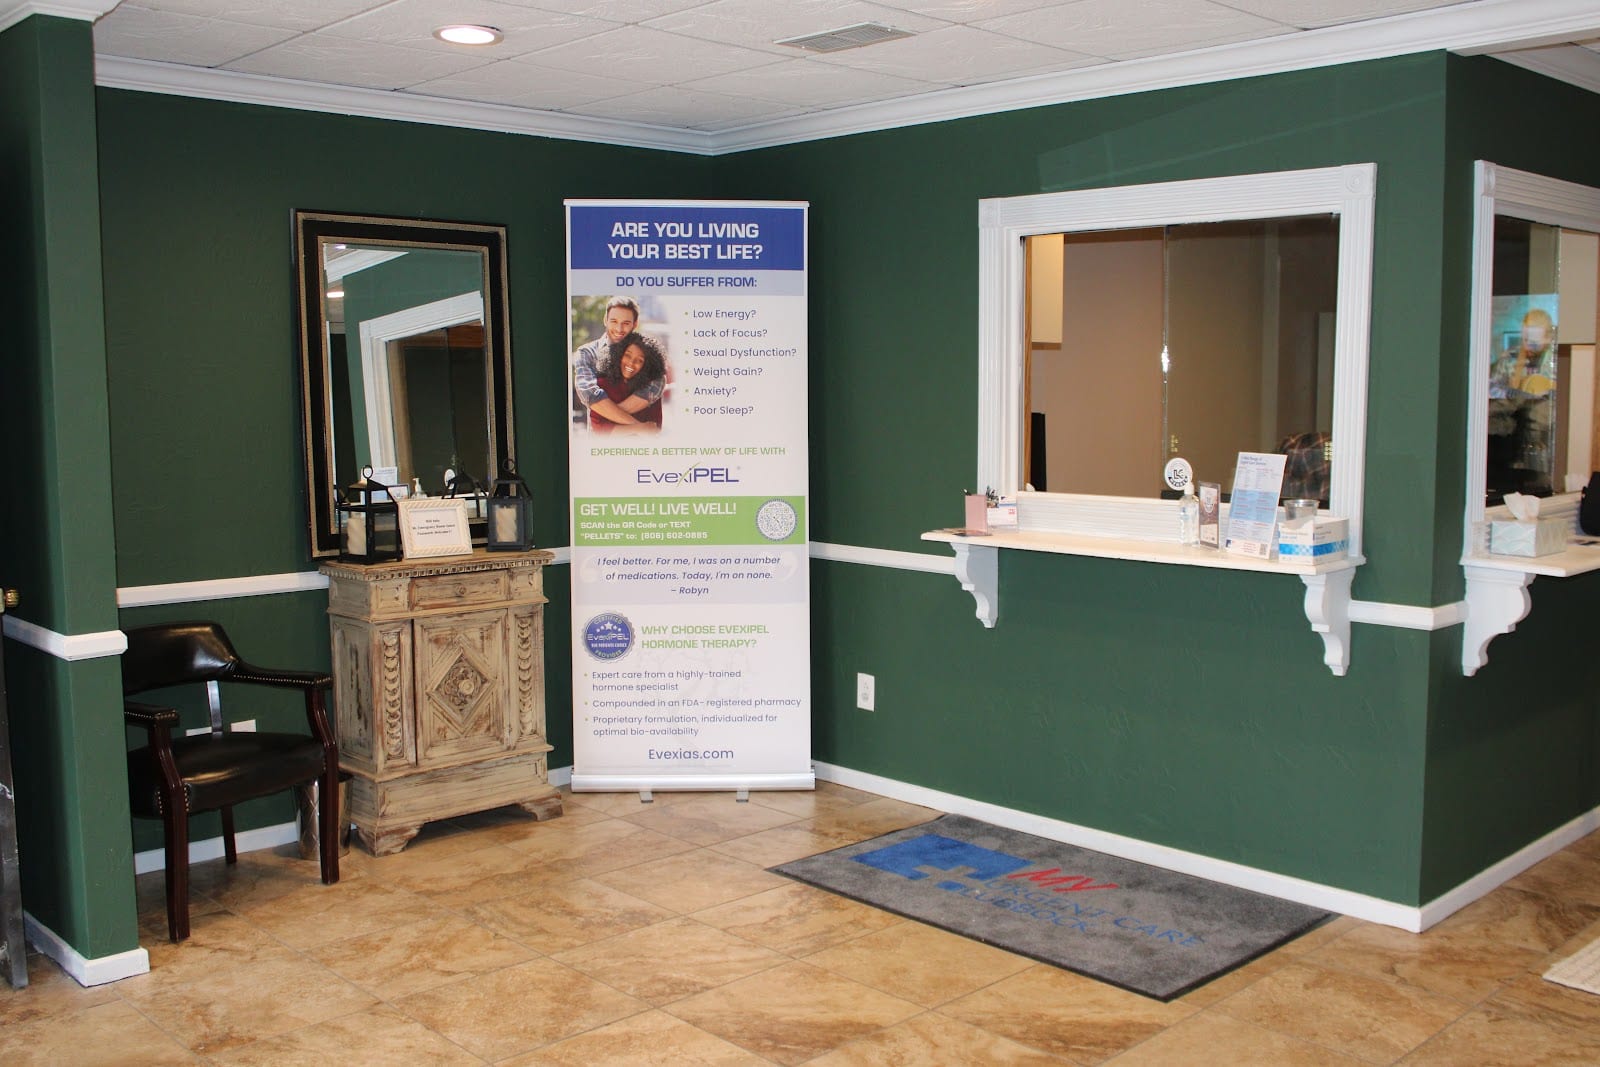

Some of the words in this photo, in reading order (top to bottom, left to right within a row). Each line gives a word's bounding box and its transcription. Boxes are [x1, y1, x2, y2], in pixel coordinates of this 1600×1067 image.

[611, 222, 649, 238] ARE
[654, 222, 693, 238] YOU
[698, 223, 759, 239] LIVING
[607, 243, 660, 259] YOUR
[665, 244, 712, 260] BEST
[716, 244, 763, 260] LIFE?
[616, 276, 634, 287] DO
[638, 276, 664, 287] YOU
[667, 277, 714, 287] SUFFER
[718, 277, 758, 287] FROM:
[693, 309, 713, 319] Low
[715, 309, 757, 321] Energy?
[693, 328, 717, 338] Lack
[719, 328, 730, 338] of
[732, 328, 768, 338] Focus?
[693, 348, 728, 357] Sexual
[730, 348, 797, 360] Dysfunction?
[693, 367, 730, 379] Weight
[733, 367, 763, 377] Gain?
[694, 386, 737, 398] Anxiety?
[694, 406, 717, 415] Poor
[720, 406, 754, 417] Sleep?
[590, 448, 650, 456] EXPERIENCE
[652, 448, 659, 456] A
[661, 447, 697, 456] BETTER
[700, 447, 722, 456] WAY
[724, 447, 737, 456] OF
[739, 447, 758, 455] LIFE
[760, 447, 786, 455] WITH
[637, 464, 740, 486] EvexiPEL
[580, 503, 608, 516] GET
[612, 503, 655, 515] WELL!
[659, 503, 690, 515] LIVE
[693, 502, 737, 515] WELL!
[636, 521, 657, 529] Code
[602, 557, 620, 566] feel
[622, 557, 654, 566] better.
[656, 557, 674, 565] For
[675, 558, 691, 567] me,
[743, 557, 781, 565] number
[605, 572, 616, 581] of
[617, 571, 679, 580] medications.
[682, 571, 713, 582] Today,
[732, 572, 745, 580] on
[679, 586, 709, 595] Robyn
[641, 626, 669, 635] WHY
[671, 625, 716, 634] CHOOSE
[718, 625, 770, 634] EVEXIPEL
[641, 640, 699, 649] HORMONE
[700, 639, 757, 649] THERAPY?
[592, 671, 620, 681] Expert
[644, 670, 666, 679] from
[676, 670, 741, 681] highly-trained
[592, 683, 634, 692] hormone
[635, 683, 679, 693] specialist
[592, 699, 656, 709] Compounded
[658, 699, 666, 707] in
[706, 698, 752, 709] registered
[754, 698, 802, 709] pharmacy
[593, 715, 643, 725] Proprietary
[644, 714, 699, 724] formulation,
[701, 714, 764, 723] individualized
[765, 714, 778, 723] for
[593, 728, 629, 738] optimal
[630, 727, 699, 737] bio-availability
[648, 749, 734, 760] Evexias.com
[1007, 868, 1120, 893] MY
[959, 887, 1093, 933] LUBBOCK
[984, 880, 1113, 918] URGENT
[1113, 916, 1205, 947] CARE
